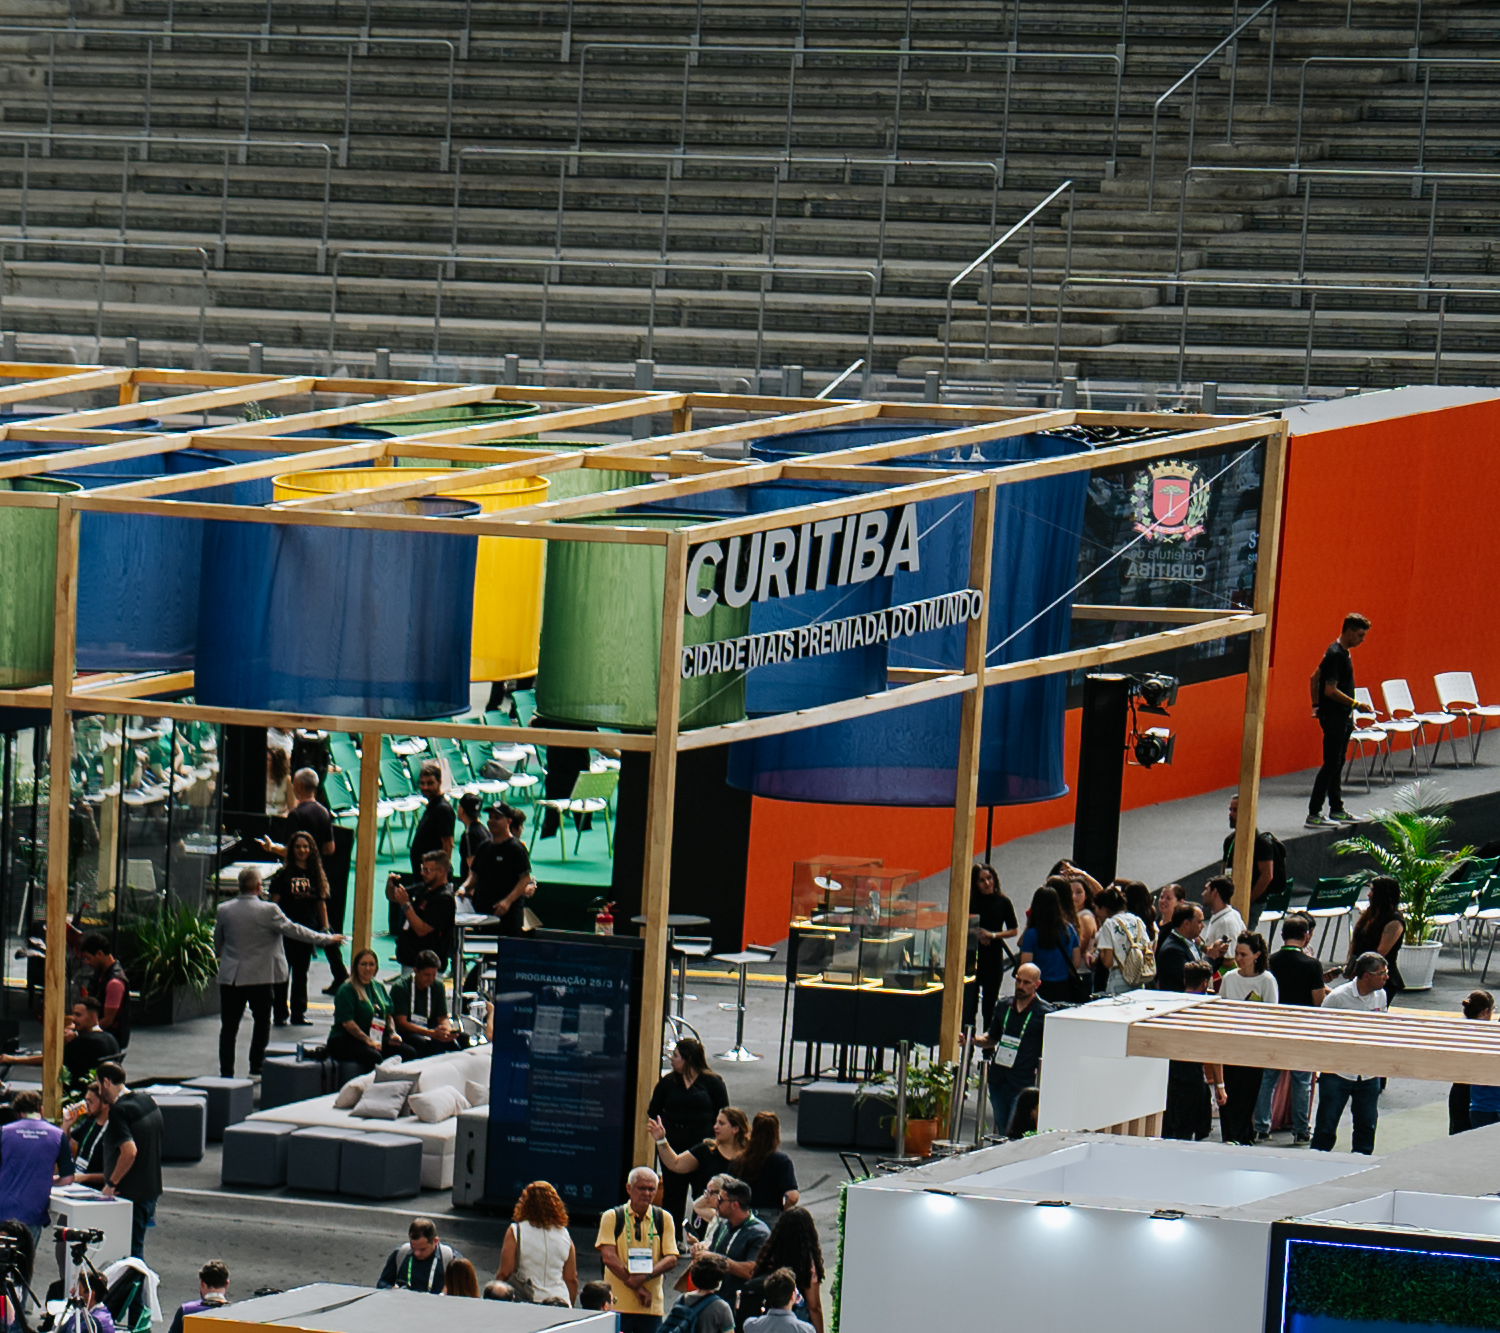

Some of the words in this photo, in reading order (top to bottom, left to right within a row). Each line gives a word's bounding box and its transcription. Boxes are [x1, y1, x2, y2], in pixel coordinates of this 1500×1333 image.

[686, 503, 919, 617] CURITIBA
[681, 642, 745, 679] CIDADE
[749, 633, 795, 669] MAIS
[799, 608, 888, 659] PREMIADA
[891, 606, 917, 640] DO
[920, 589, 983, 634] MUNDO
[515, 972, 586, 987] PROGRAMAÇÃO
